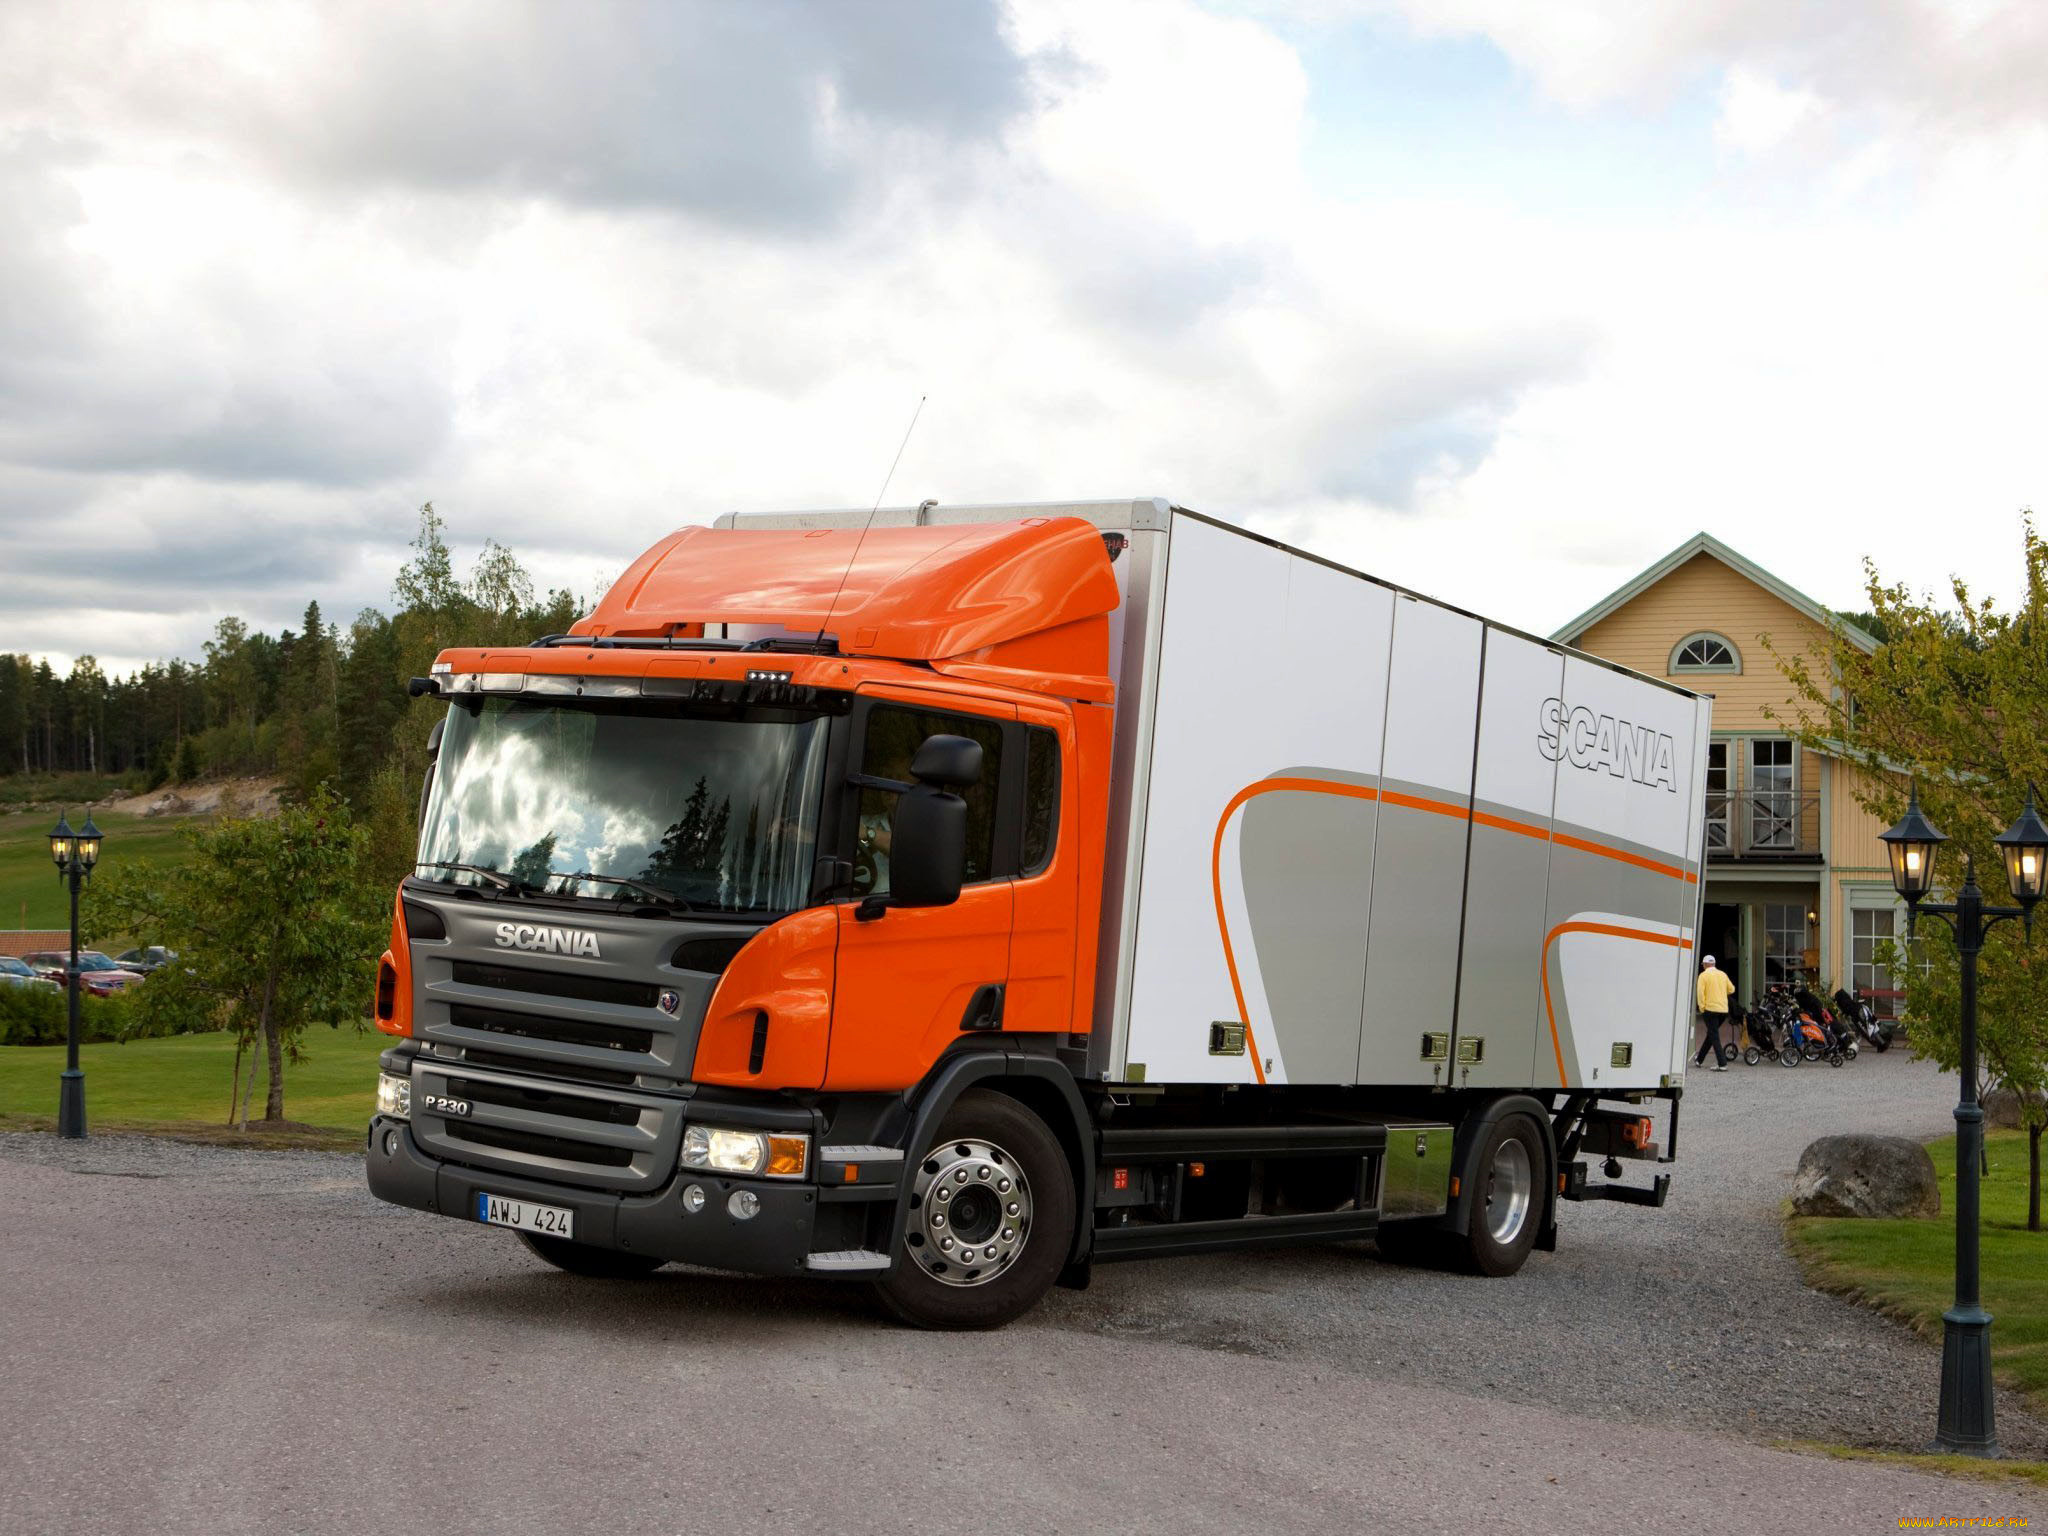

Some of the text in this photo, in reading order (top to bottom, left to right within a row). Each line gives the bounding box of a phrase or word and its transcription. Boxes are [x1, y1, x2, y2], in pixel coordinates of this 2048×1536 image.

[1537, 697, 1677, 793] SCANIA
[494, 922, 601, 958] SCANIA
[425, 1095, 468, 1115] P 230
[490, 1199, 567, 1234] AWJ 424
